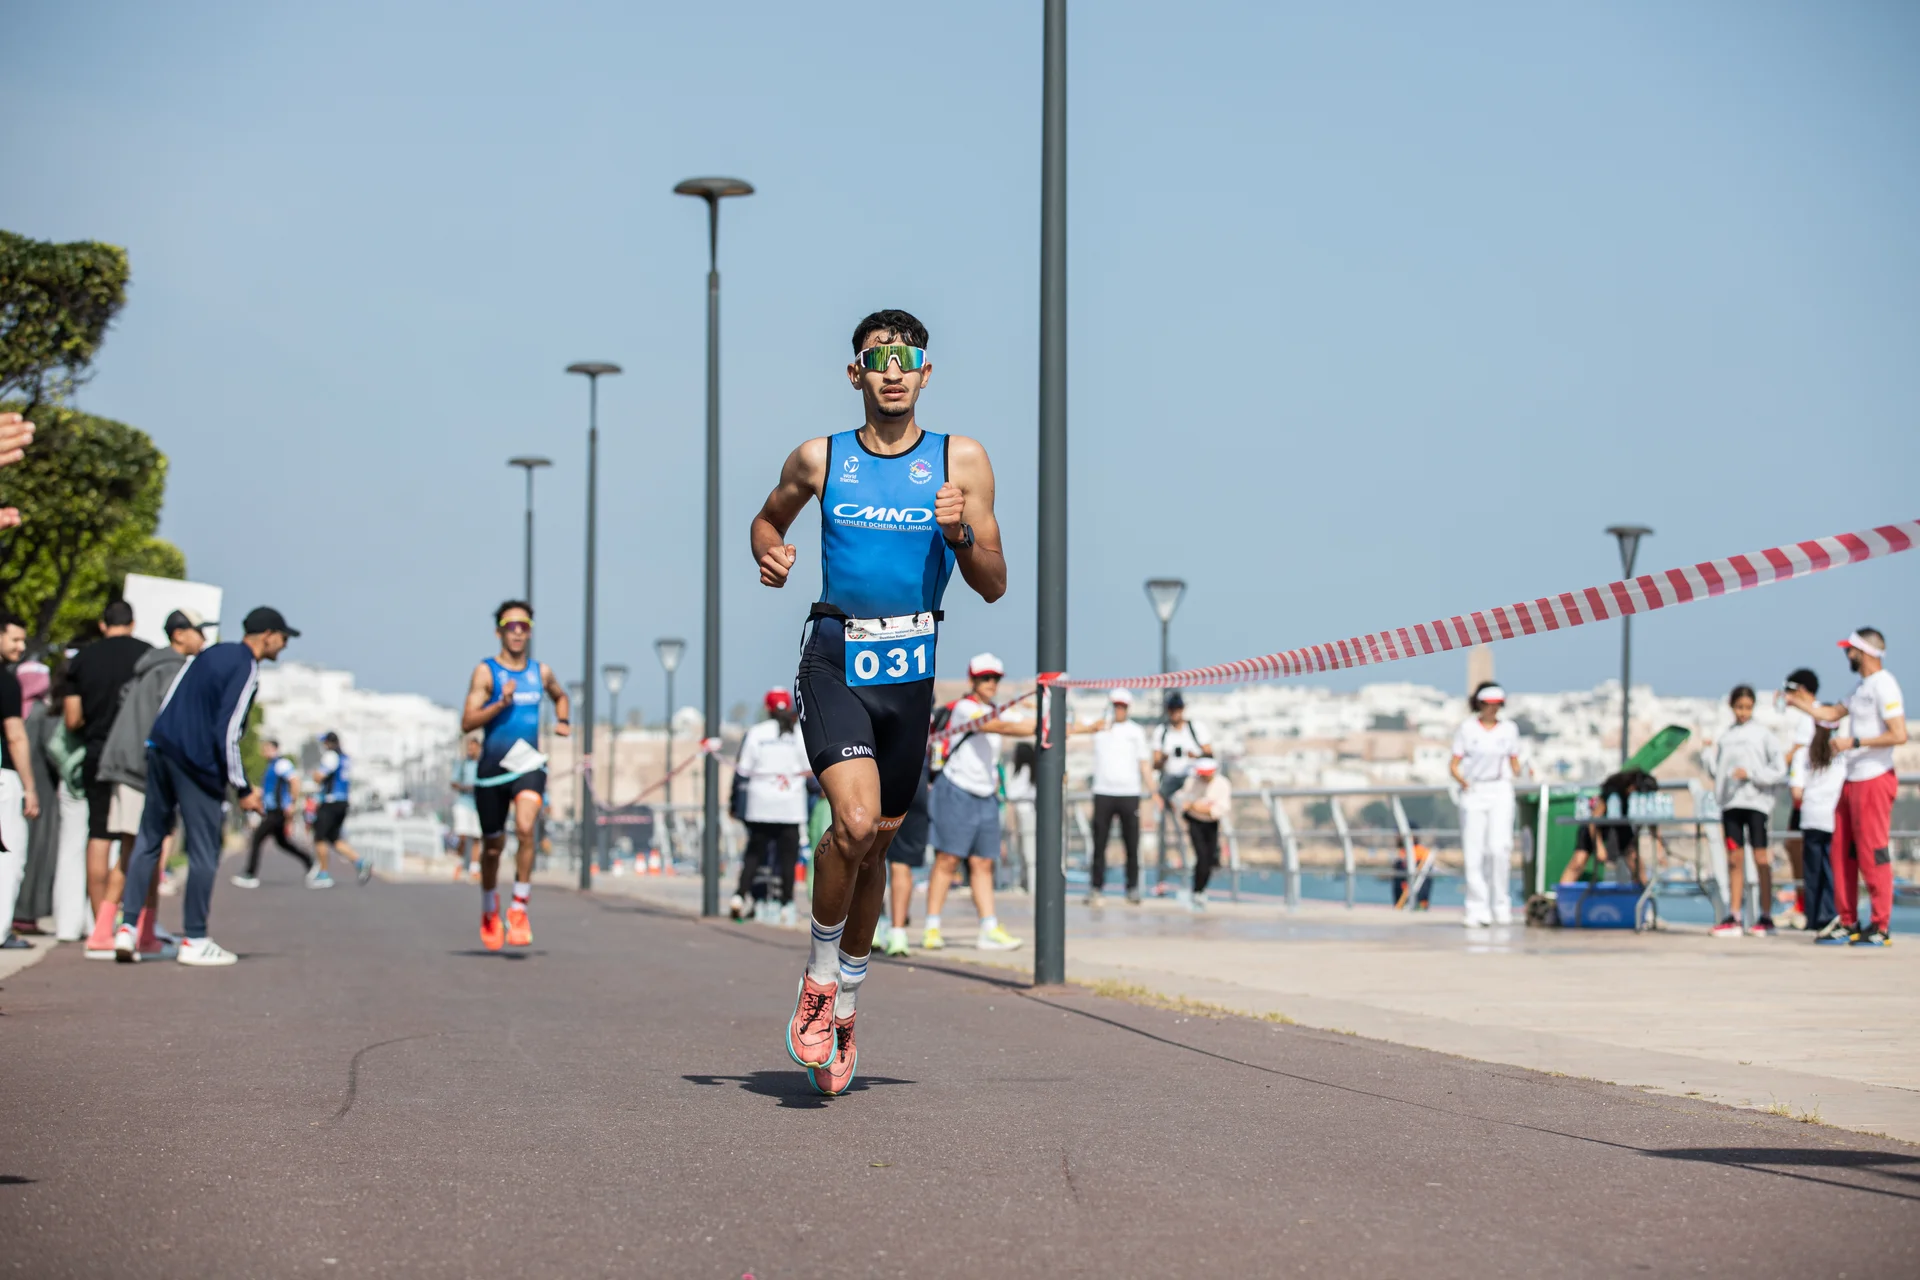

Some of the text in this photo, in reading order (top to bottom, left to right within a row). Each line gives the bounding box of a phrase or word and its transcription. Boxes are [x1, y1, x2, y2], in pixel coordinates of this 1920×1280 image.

[833, 504, 932, 522] CMND
[834, 518, 866, 527] TRIATHLETE
[868, 520, 898, 530] DCHEIRA
[854, 643, 926, 680] 031
